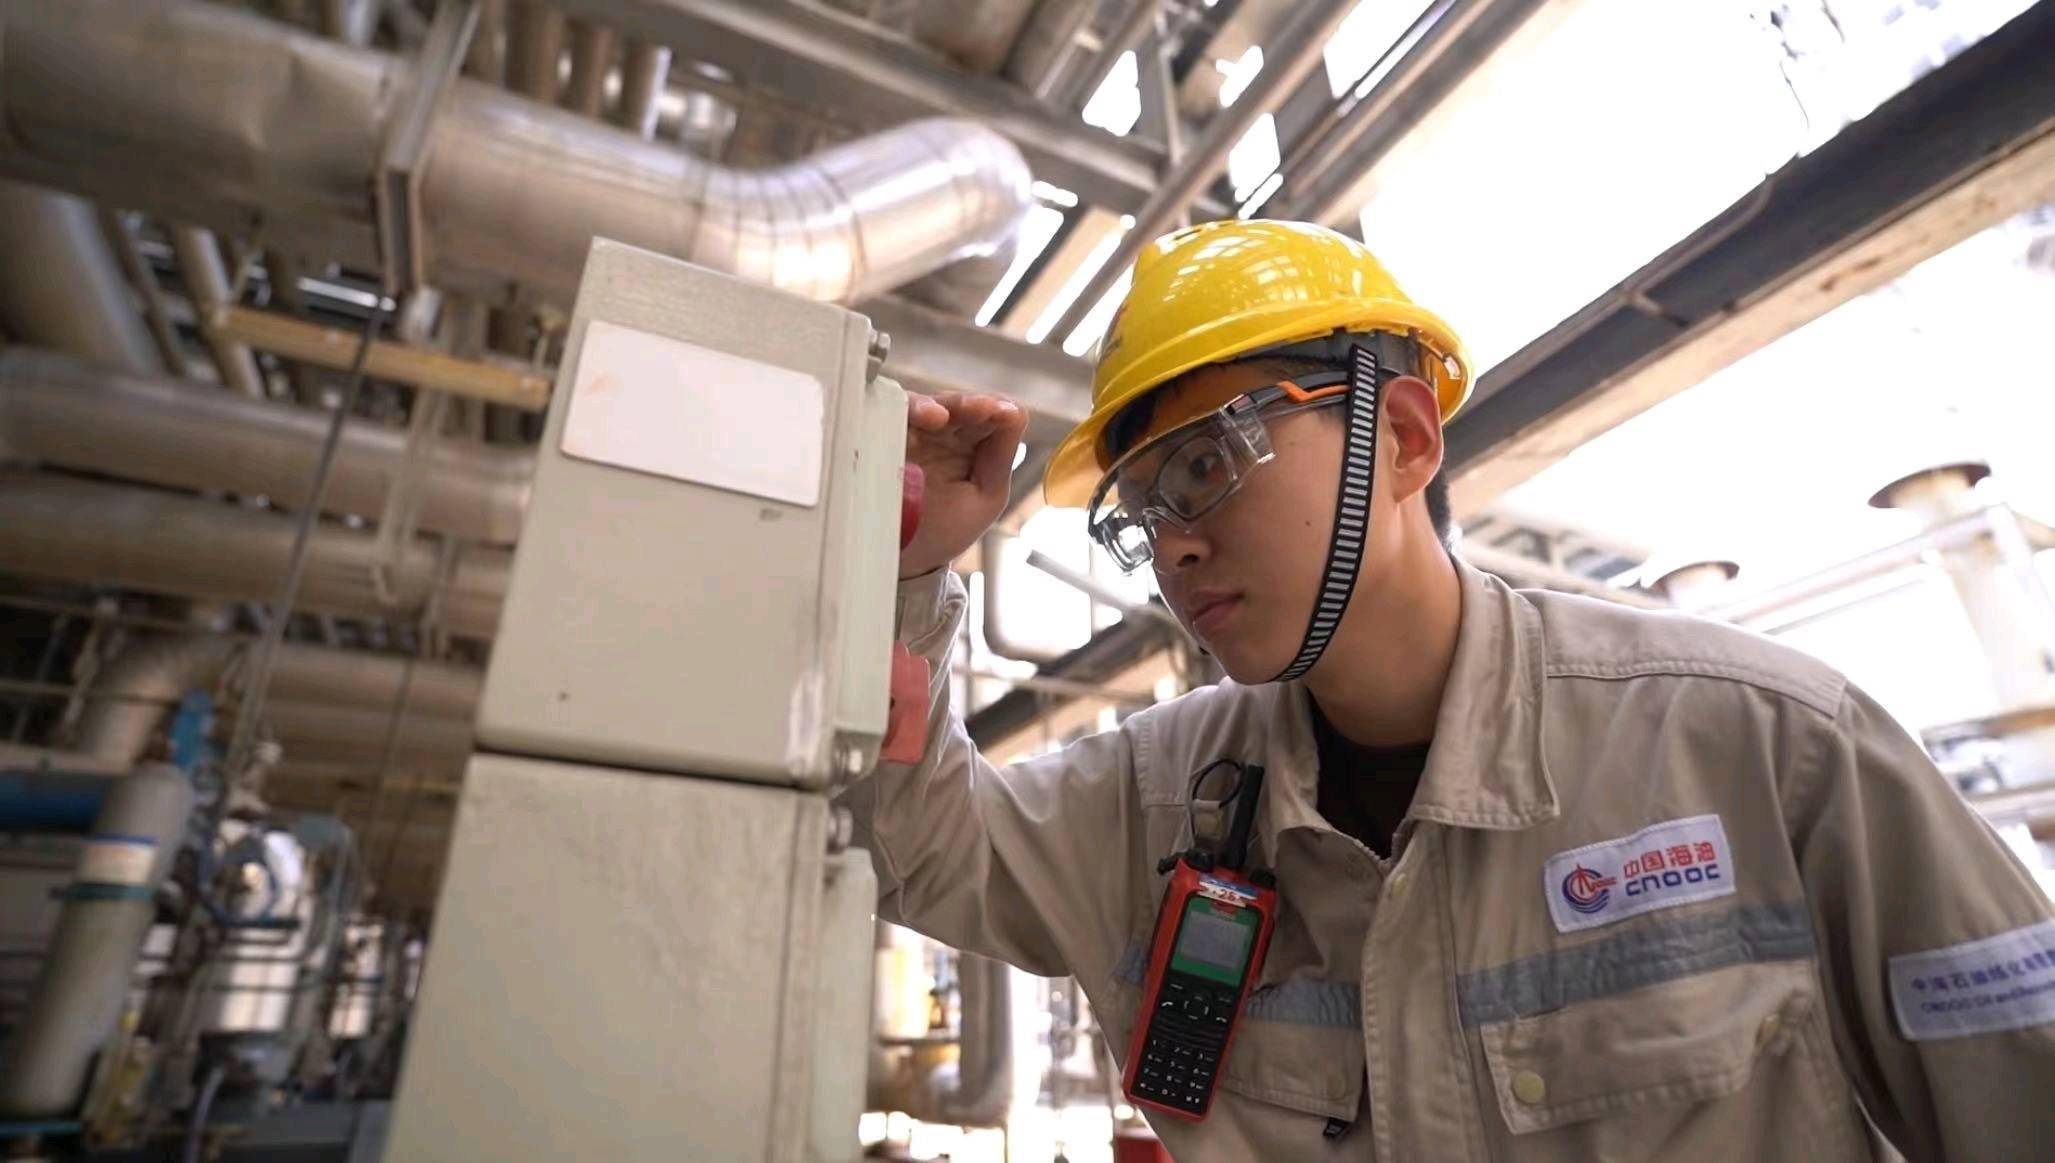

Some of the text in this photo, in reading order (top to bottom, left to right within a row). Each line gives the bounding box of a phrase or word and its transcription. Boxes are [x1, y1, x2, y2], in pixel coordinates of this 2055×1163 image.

[1623, 841, 1716, 878] 中国海油
[1625, 863, 1720, 897] CNOOC
